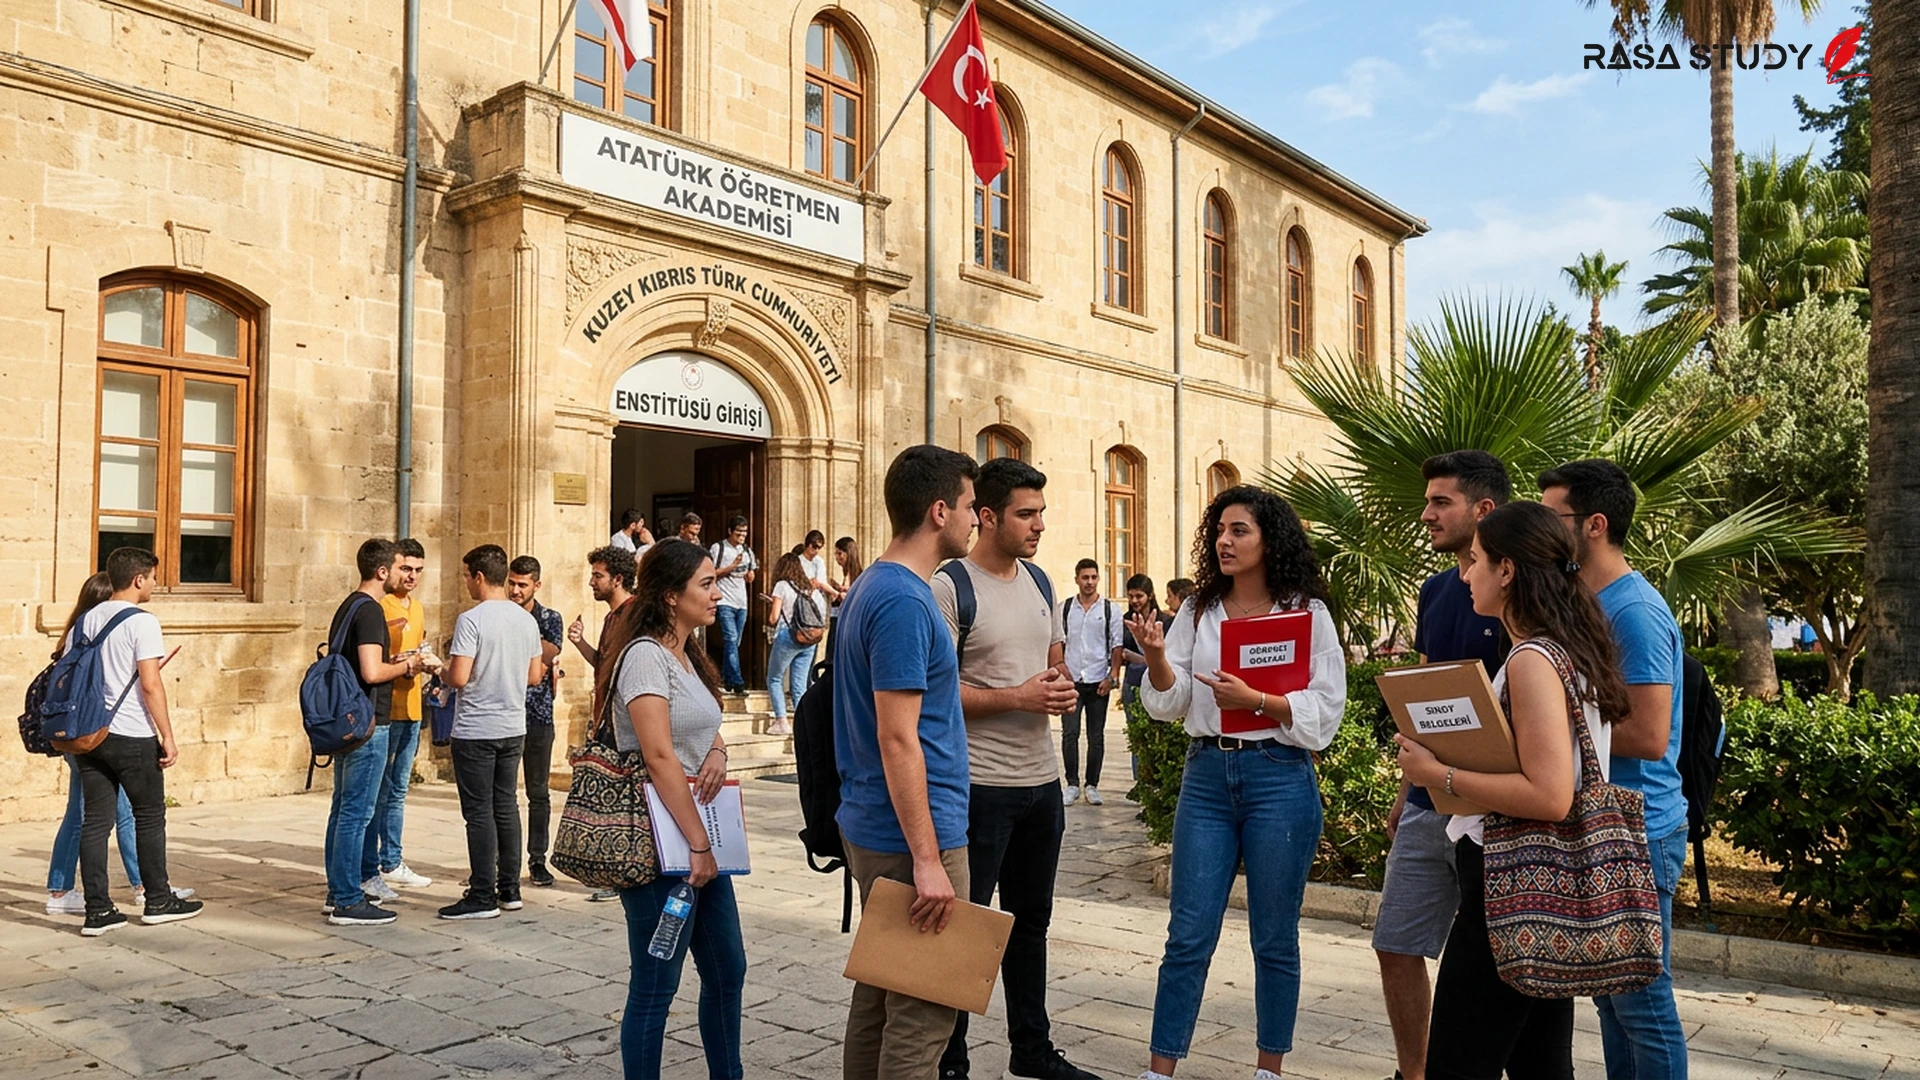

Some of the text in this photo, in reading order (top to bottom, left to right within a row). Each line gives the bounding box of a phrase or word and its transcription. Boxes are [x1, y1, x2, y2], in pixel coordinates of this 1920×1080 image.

[597, 136, 840, 224] ATATÜRK ÖĞRETMEN
[663, 185, 792, 238] AKADEMİSİ
[582, 284, 635, 344] KUZEY
[637, 266, 696, 297] KIBRIS
[700, 264, 747, 295] TÜRK
[616, 390, 763, 431] ENSTİTÜSÜ GİRİŞİ
